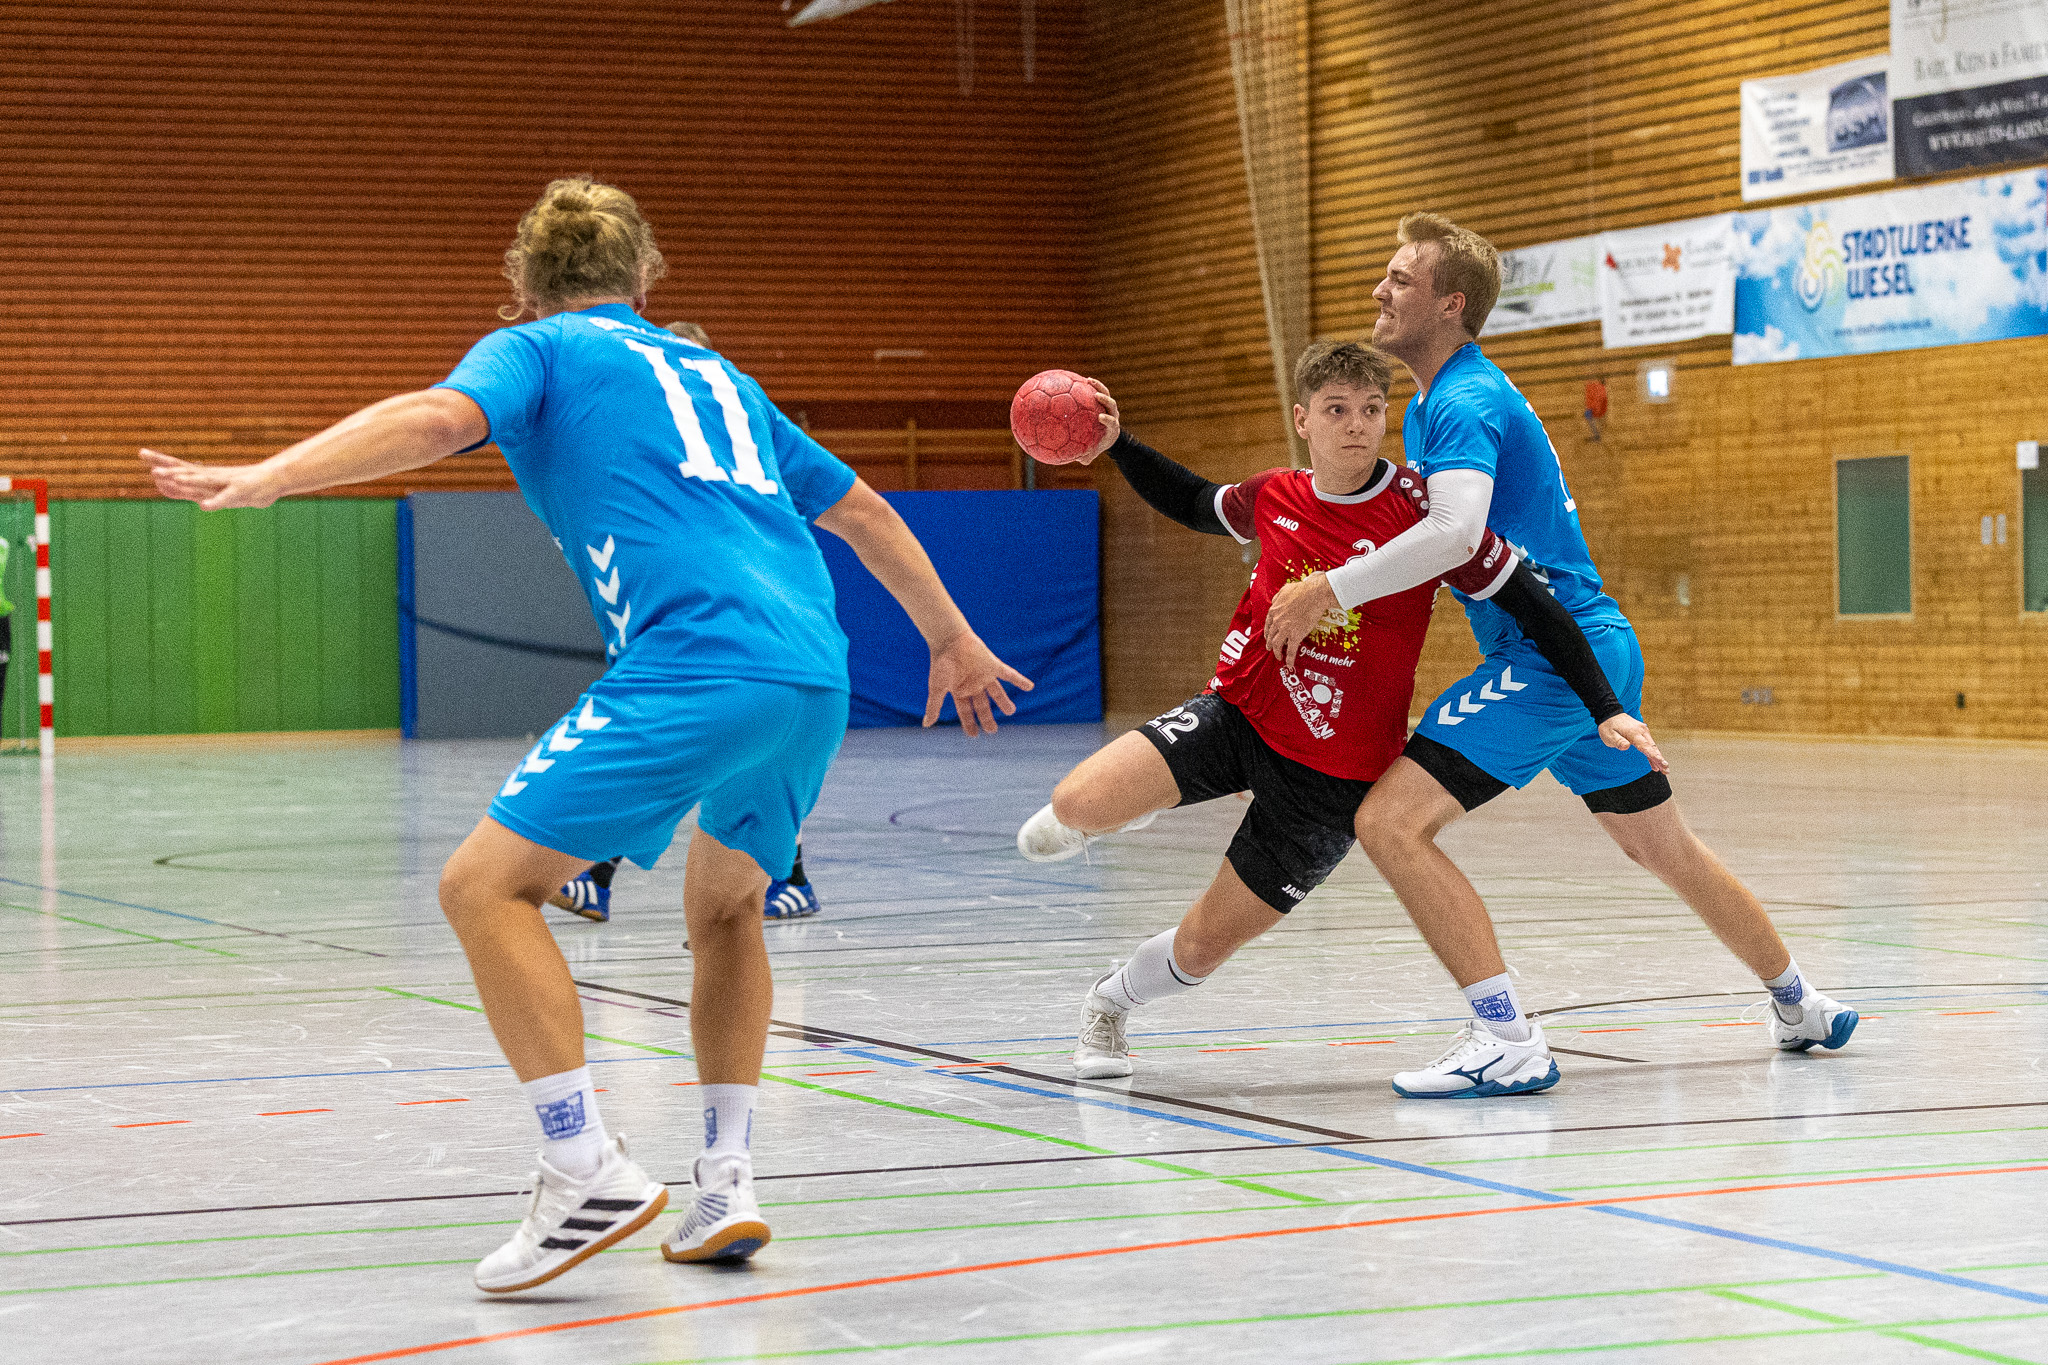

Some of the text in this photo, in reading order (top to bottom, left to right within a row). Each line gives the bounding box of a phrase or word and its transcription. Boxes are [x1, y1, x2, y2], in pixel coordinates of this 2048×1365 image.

[1842, 215, 1972, 263] STADTWERKE
[1847, 262, 1916, 299] WESEL
[624, 338, 779, 495] 11
[1273, 515, 1299, 532] JAKO
[1299, 645, 1356, 668] geben mehr
[1282, 665, 1333, 736] BORGMANN
[1145, 706, 1200, 744] 22
[1281, 883, 1306, 900] JAKO
